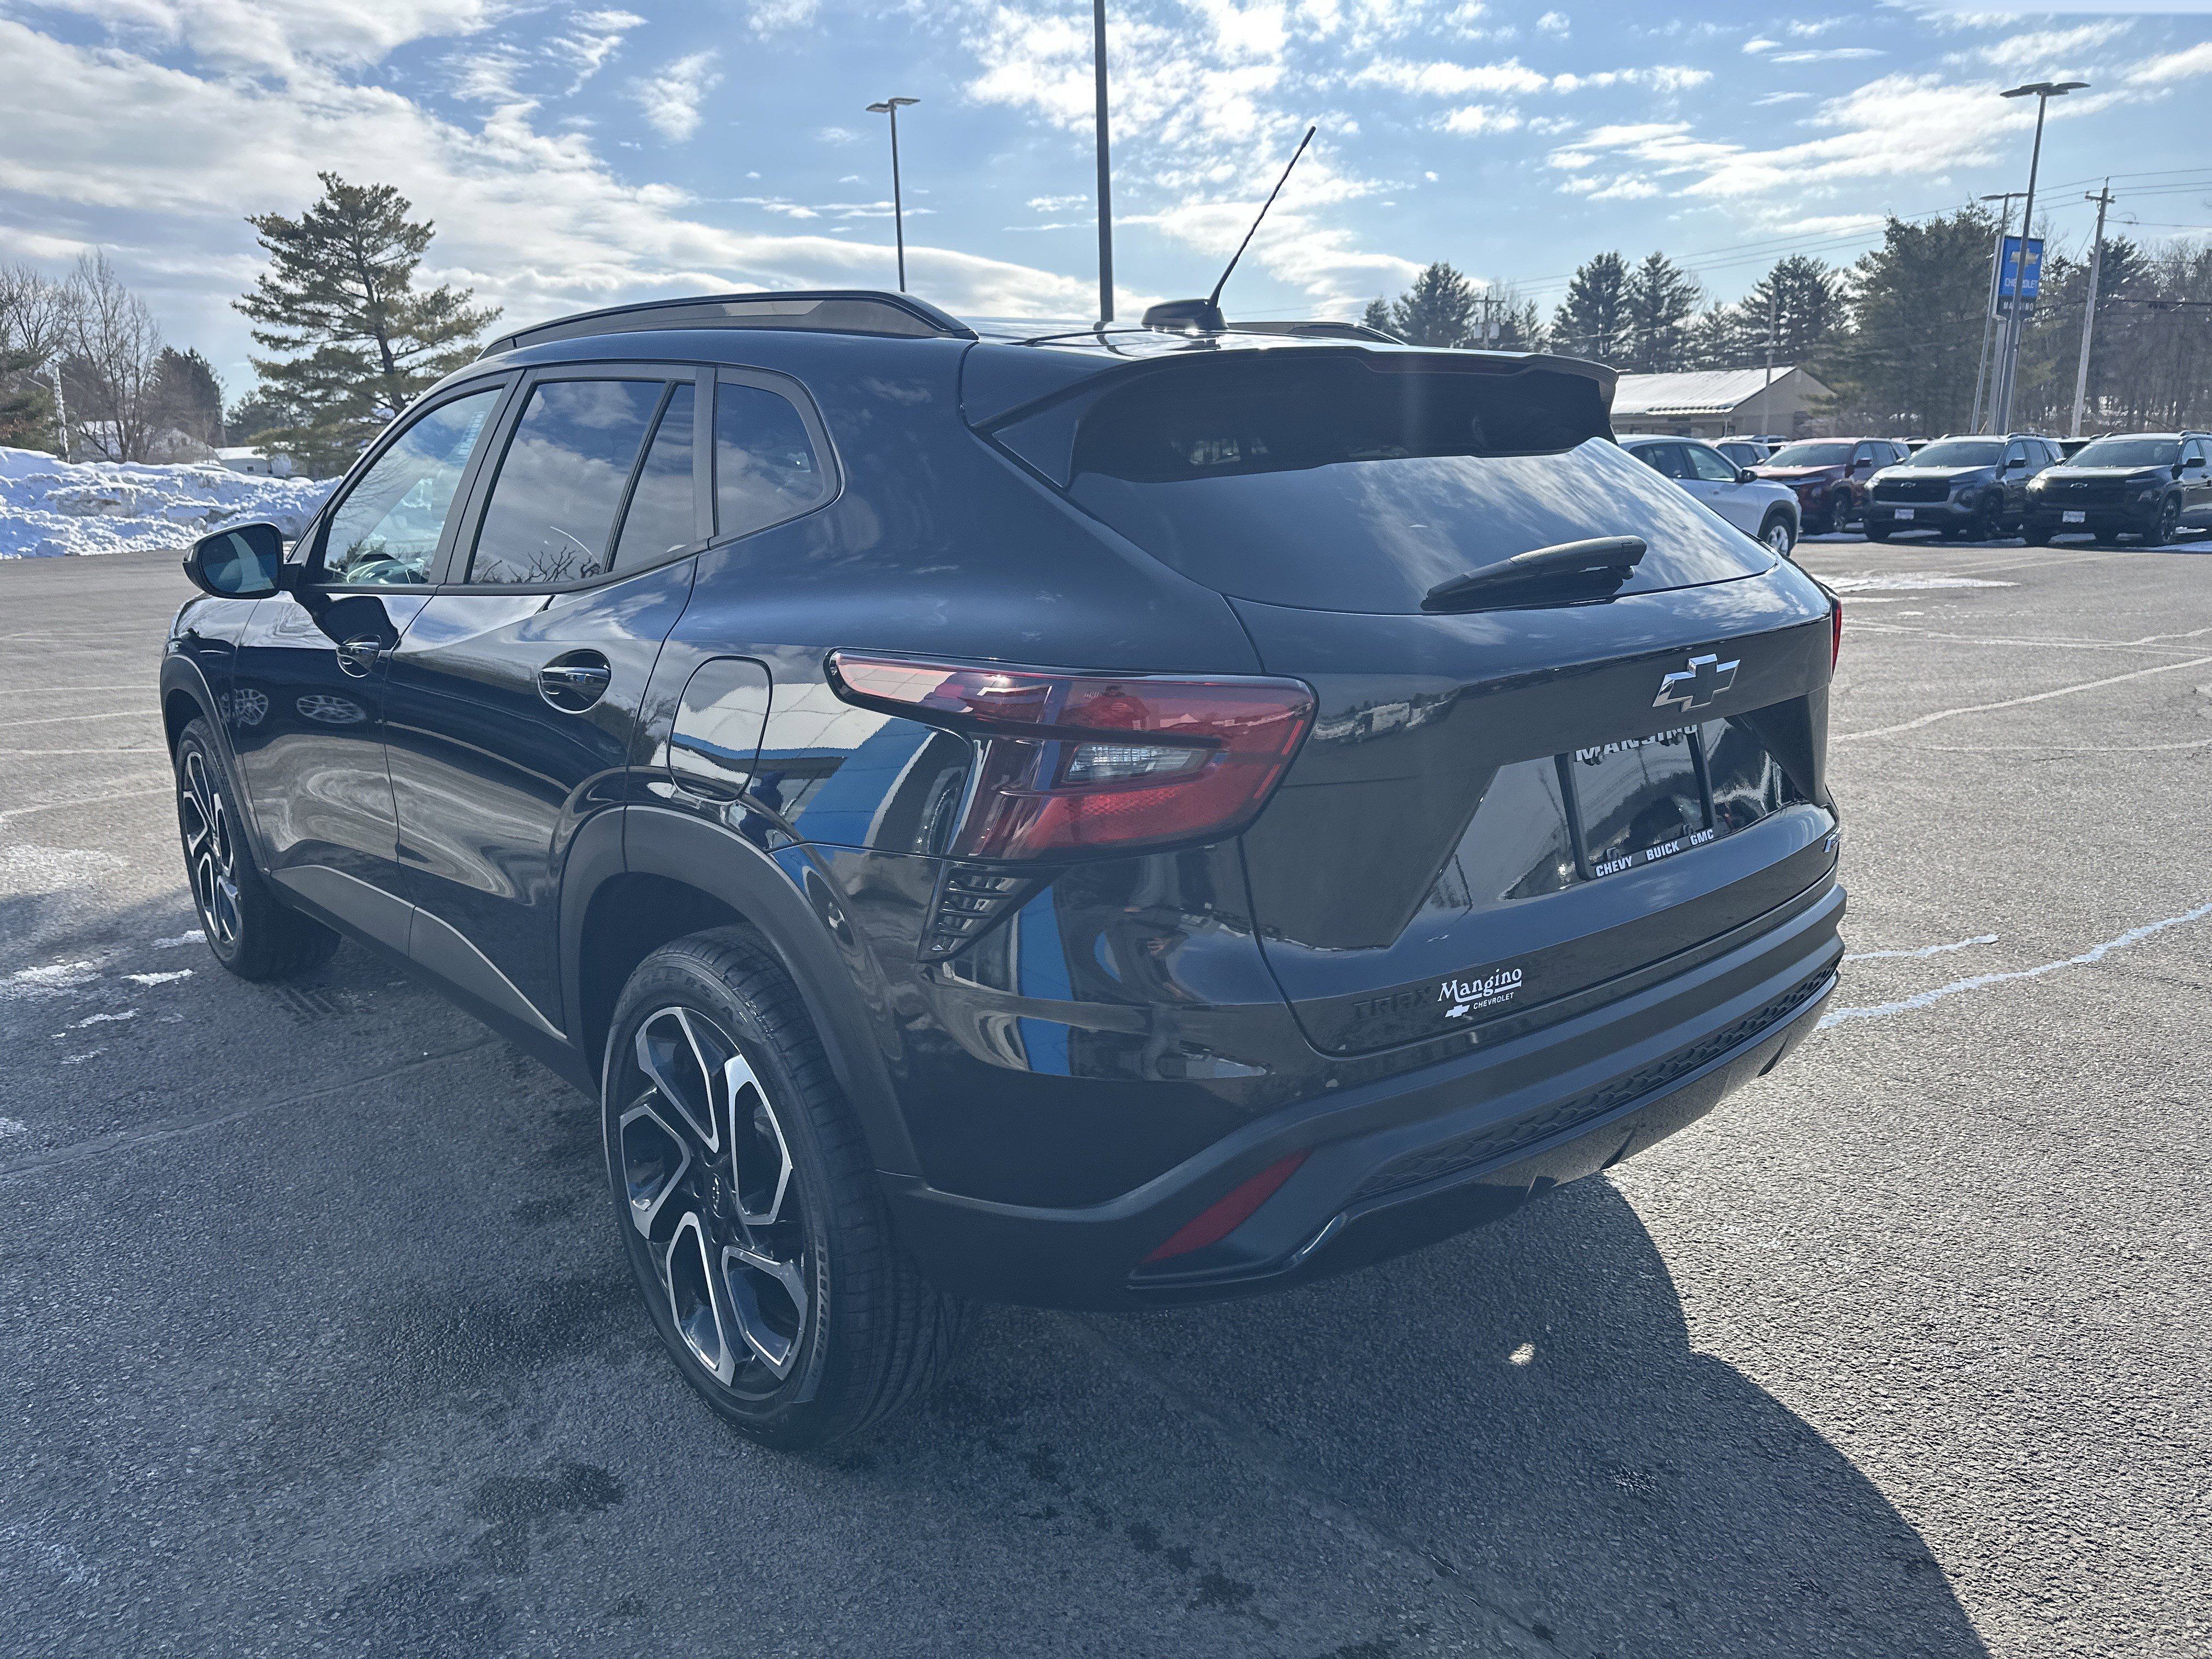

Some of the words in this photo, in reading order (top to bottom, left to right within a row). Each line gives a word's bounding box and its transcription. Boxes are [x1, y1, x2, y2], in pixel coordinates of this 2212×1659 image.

[2005, 277, 2039, 289] CHEOLET
[2003, 301, 2034, 311] MAINO
[1595, 856, 1632, 877] CHEVY
[1646, 840, 1680, 861] BUICK
[1690, 829, 1714, 845] GMC
[1437, 968, 1522, 1003] Mangino
[1473, 992, 1514, 1009] CHEVROLET
